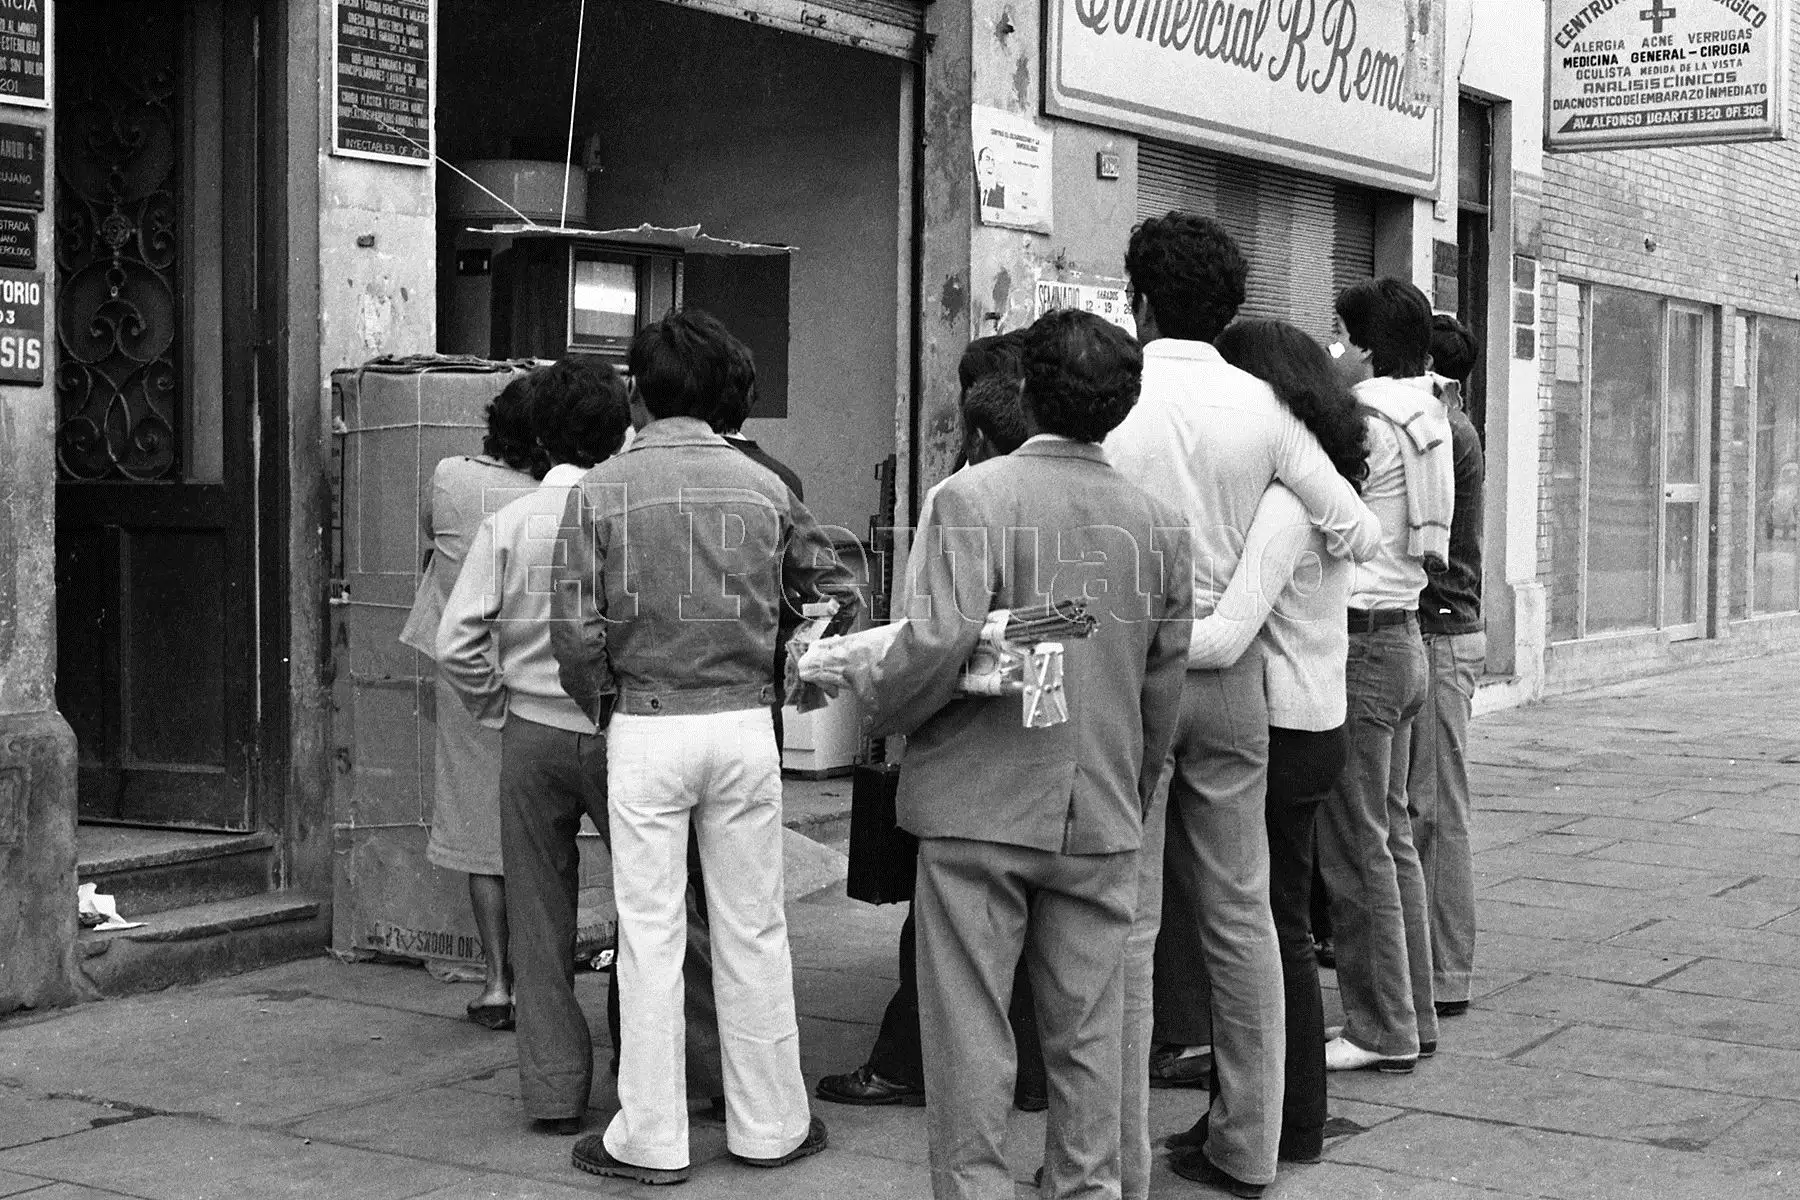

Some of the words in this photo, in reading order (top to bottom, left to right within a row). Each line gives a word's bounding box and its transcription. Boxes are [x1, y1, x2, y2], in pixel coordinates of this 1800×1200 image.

[1573, 39, 1626, 53] ALERGIA
[1641, 35, 1674, 49] ACNE
[1687, 28, 1753, 44] VERRUGAS
[1563, 53, 1619, 69] MEDICINA
[1630, 47, 1687, 64] GENERAL
[1700, 42, 1751, 58] CIRUGIA
[1576, 66, 1632, 81] OCULISTA
[1641, 64, 1676, 76] MEDIDA
[1680, 63, 1692, 73] DE
[1695, 62, 1708, 71] LA
[1712, 58, 1743, 69] VISTA
[1583, 78, 1661, 95] ANALISIS
[1641, 88, 1704, 105] EMBARAZO
[1705, 83, 1767, 99] INMEDIATO
[1591, 113, 1642, 128] ALFONSO
[1646, 109, 1694, 125] UGARTE
[345, 137, 396, 155] INYECTABLES
[0, 336, 41, 370] SIS
